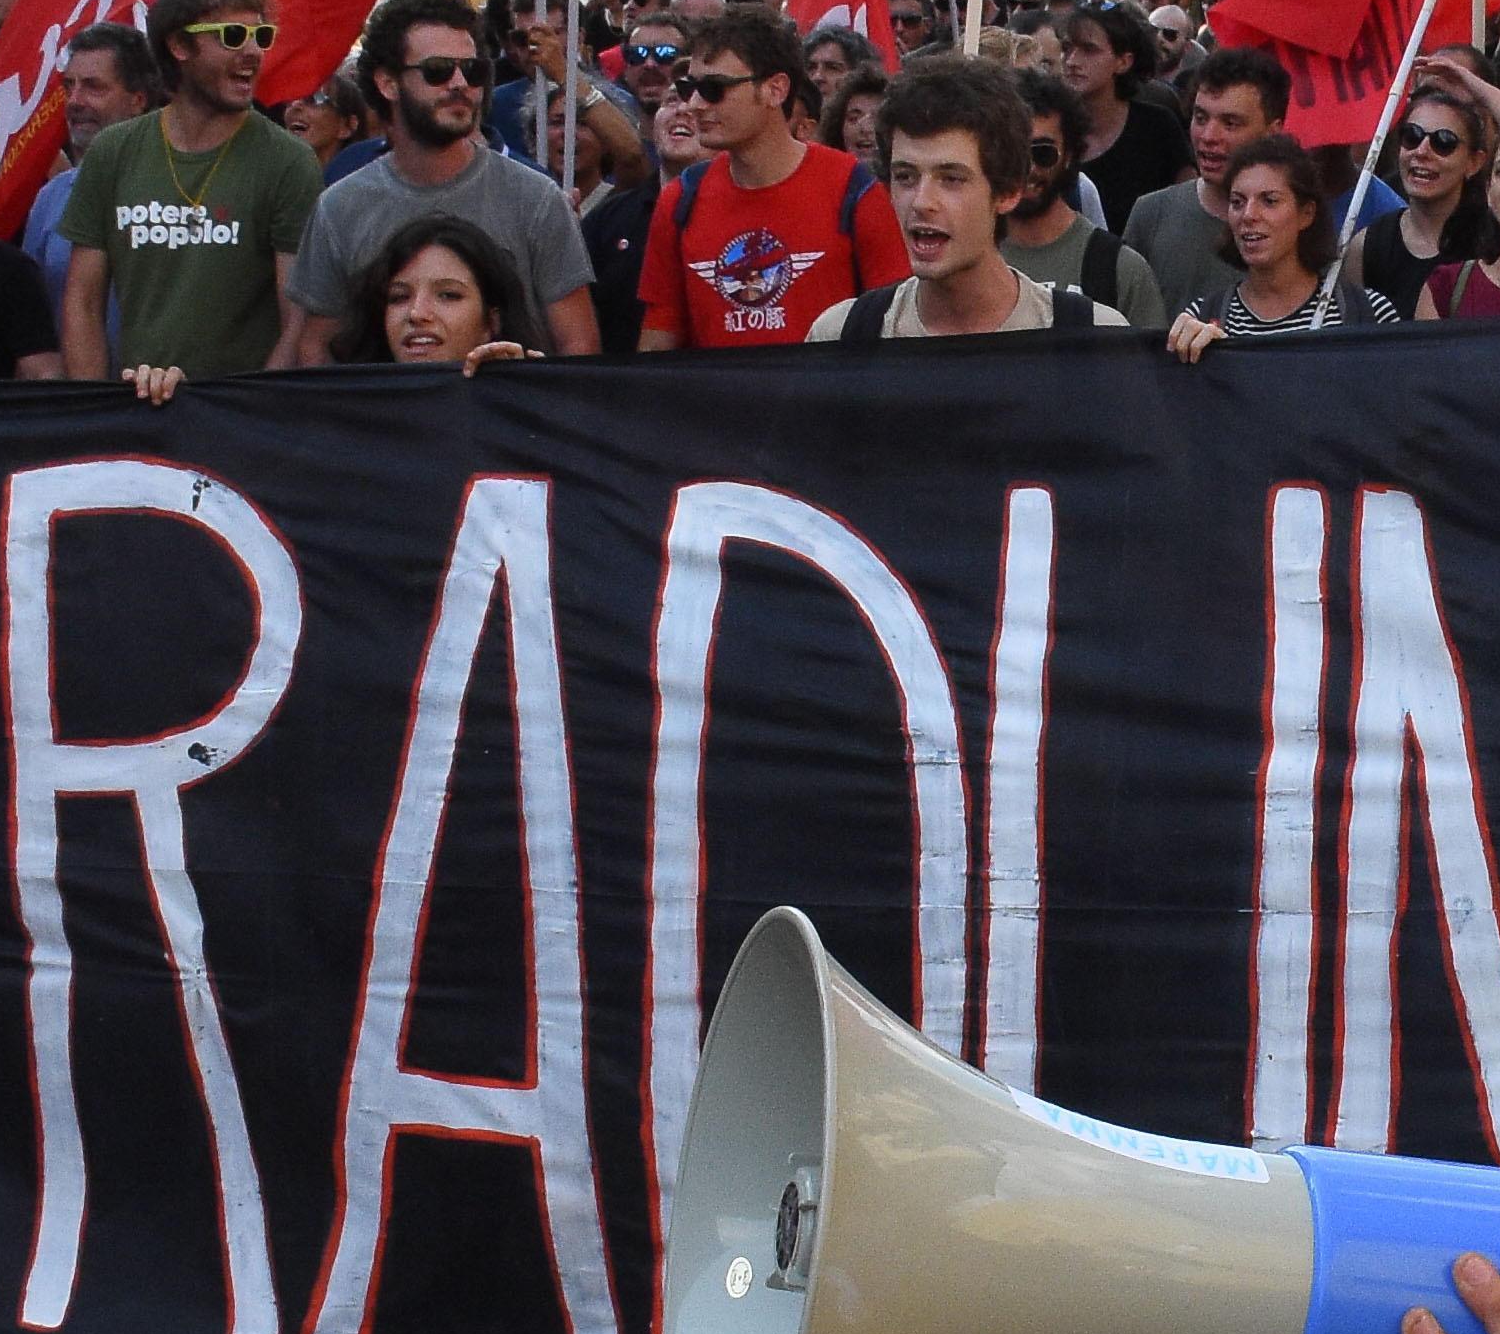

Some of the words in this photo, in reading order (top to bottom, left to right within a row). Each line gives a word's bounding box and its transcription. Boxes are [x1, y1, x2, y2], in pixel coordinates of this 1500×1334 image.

[116, 200, 208, 230] potere
[131, 219, 240, 249] popolo!
[724, 307, 786, 332] 紅の豚
